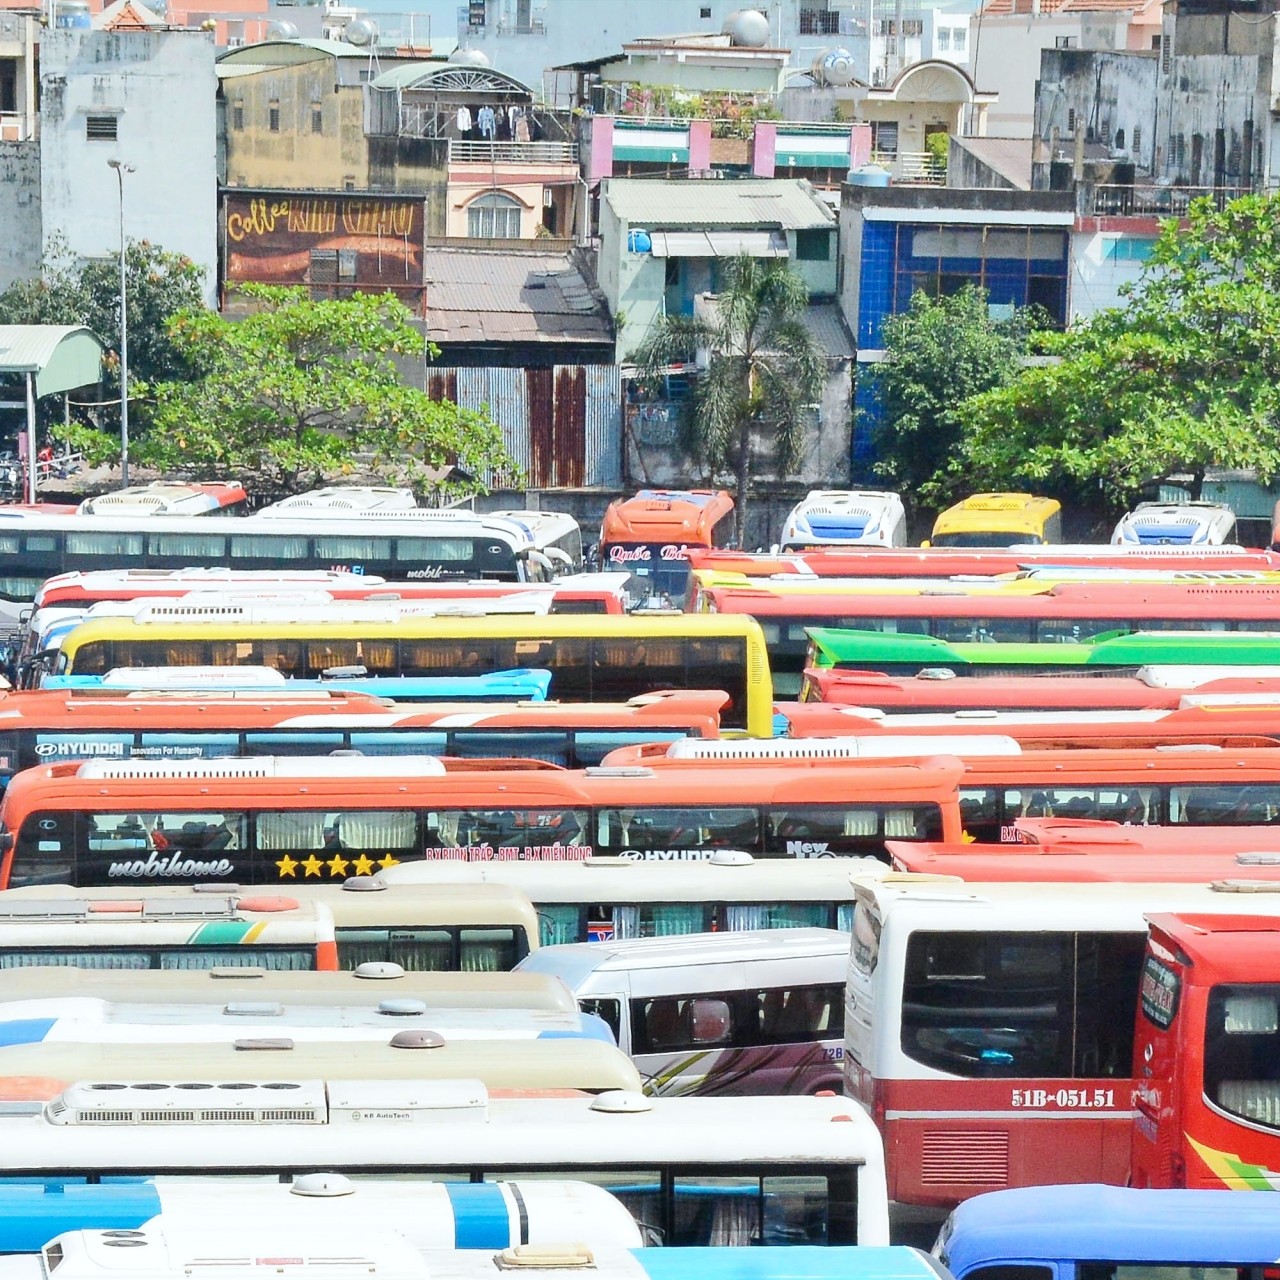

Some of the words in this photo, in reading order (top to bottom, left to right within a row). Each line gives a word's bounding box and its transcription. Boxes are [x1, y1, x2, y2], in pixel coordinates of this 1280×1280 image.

[228, 198, 289, 242] Coffee
[58, 742, 124, 755] HYUNDAI
[129, 746, 162, 756] Innovation
[163, 746, 174, 756] For
[174, 746, 203, 757] Humanity
[786, 840, 828, 856] New
[108, 850, 234, 878] mobihome
[376, 1111, 411, 1120] AutoTech
